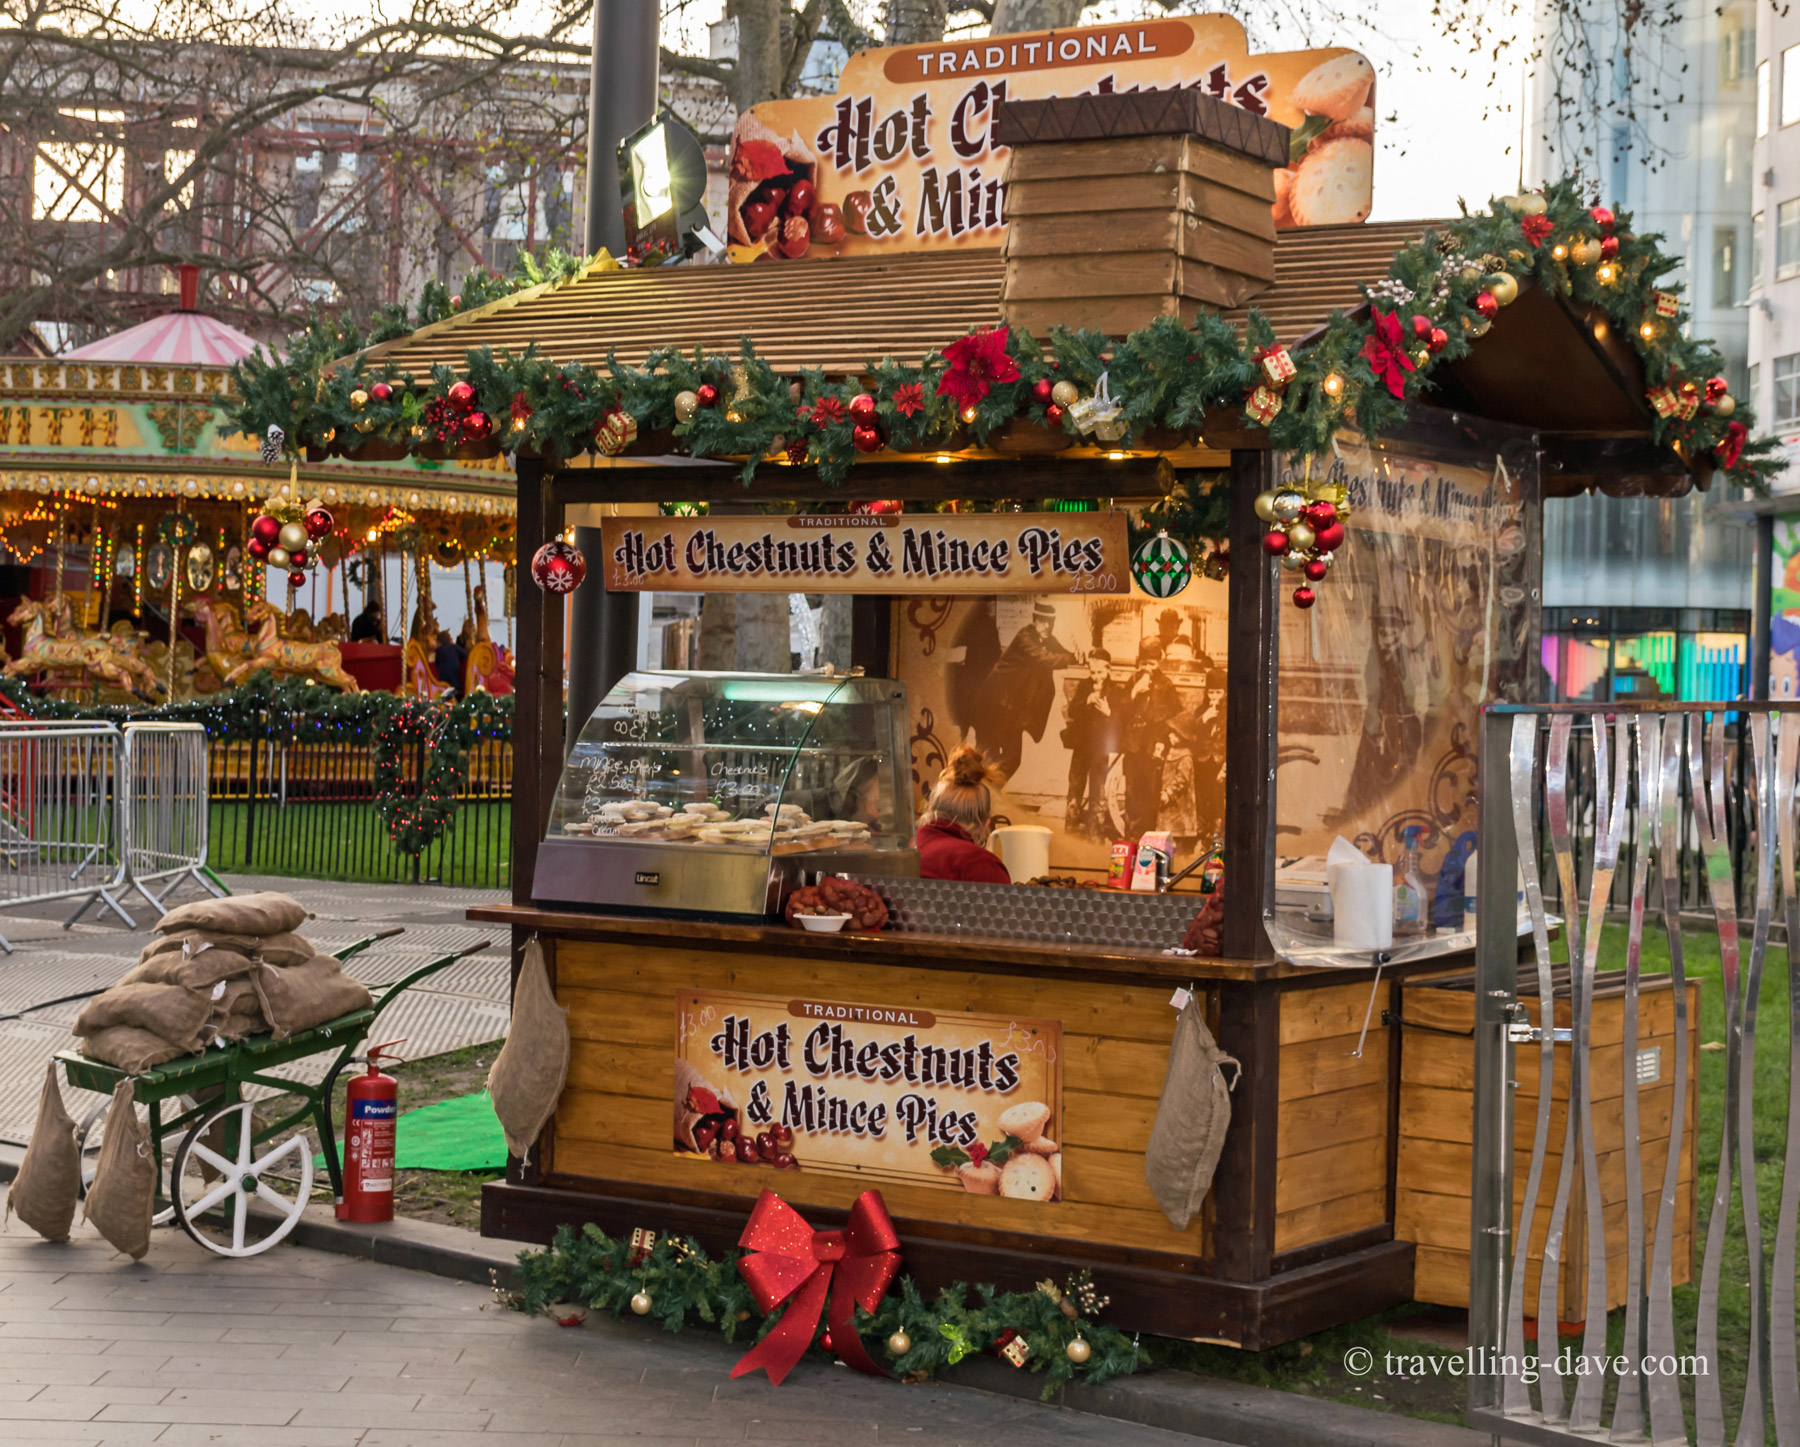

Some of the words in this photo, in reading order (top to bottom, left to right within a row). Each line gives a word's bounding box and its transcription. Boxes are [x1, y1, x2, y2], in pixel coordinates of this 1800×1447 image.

[916, 30, 1157, 76] TRADITIONAL
[816, 92, 933, 172] Hot
[866, 174, 903, 236] &
[916, 167, 1010, 236] Min
[614, 529, 677, 577] Hot
[685, 529, 857, 575] Chestnuts
[865, 529, 893, 573] &
[902, 526, 1009, 577] Mince
[1017, 526, 1103, 575] Pies
[798, 517, 887, 527] TRADITIONAL
[802, 1002, 920, 1026] TRADITIONAL
[709, 1014, 792, 1072] Hot
[803, 1021, 1020, 1093] Chestnuts
[746, 1079, 772, 1124] &
[781, 1079, 888, 1137] Mince
[895, 1093, 978, 1146] Pies
